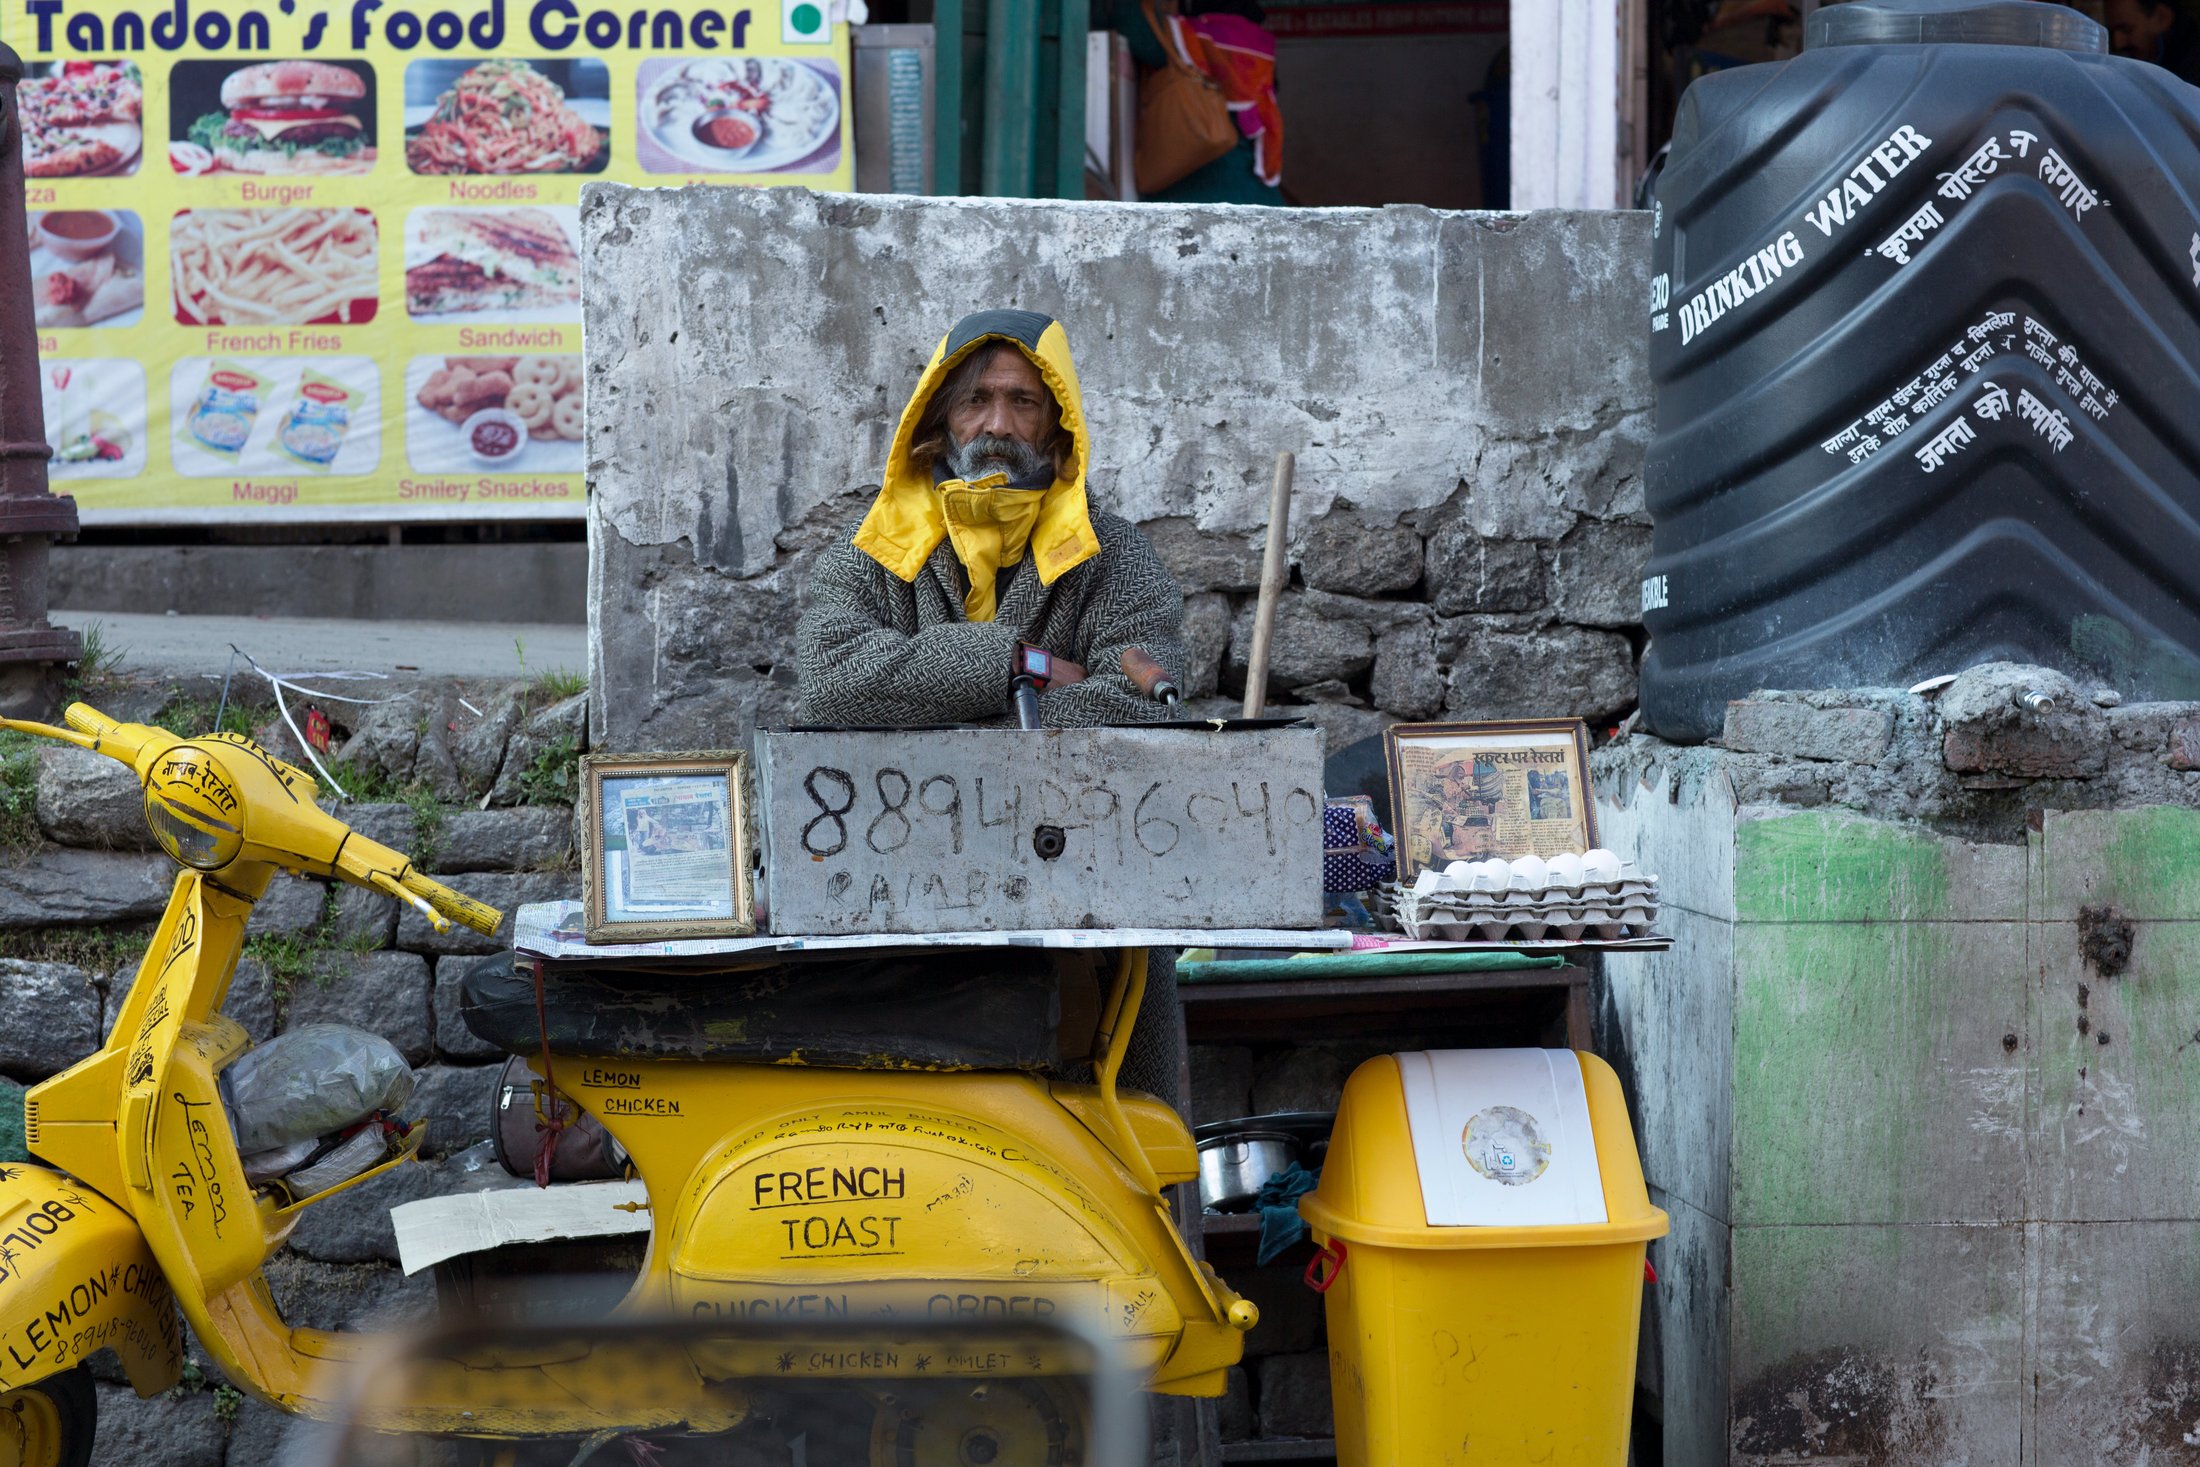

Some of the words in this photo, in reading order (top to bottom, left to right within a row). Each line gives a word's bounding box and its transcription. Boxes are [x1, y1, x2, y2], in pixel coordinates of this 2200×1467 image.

[26, 0, 328, 53] Tandon's
[351, 0, 505, 51] Food
[529, 0, 752, 51] Corner
[1935, 136, 2013, 201] पोस्टर
[2009, 129, 2039, 158] न
[241, 182, 315, 207] Burger
[449, 180, 538, 201] Noodles
[1678, 230, 1805, 346] DRINKING
[1804, 123, 1933, 238] WATER
[207, 332, 282, 352] French
[288, 333, 342, 352] Fries
[458, 329, 563, 348] Sandwich
[1820, 418, 1864, 455] लाला
[1864, 399, 1896, 426] शाम
[2023, 316, 2058, 347] गुप्ता
[2057, 344, 2079, 368] की
[2079, 364, 2106, 395] याद
[1911, 370, 1958, 414] कार्तिक
[1959, 341, 1996, 374] गुप्ता
[2055, 365, 2084, 397] गुप्ता
[1914, 415, 1978, 473] जनता
[1972, 381, 2013, 421] को
[2016, 387, 2075, 455] समर्पित
[233, 481, 299, 504] Maggi
[398, 479, 471, 502] Smiley
[476, 479, 569, 498] Snackes
[1472, 751, 1509, 768] स्कूटर
[1511, 751, 1529, 764] पर
[583, 1069, 641, 1087] LEMON
[605, 1098, 681, 1114] CHICKEN
[172, 1161, 196, 1221] TEA
[754, 1166, 905, 1206] FRENCH
[2, 1199, 77, 1250] BOIL
[780, 1216, 903, 1251] TOAST
[8, 1269, 109, 1371] LEMON
[809, 1351, 899, 1369] CHICKEN
